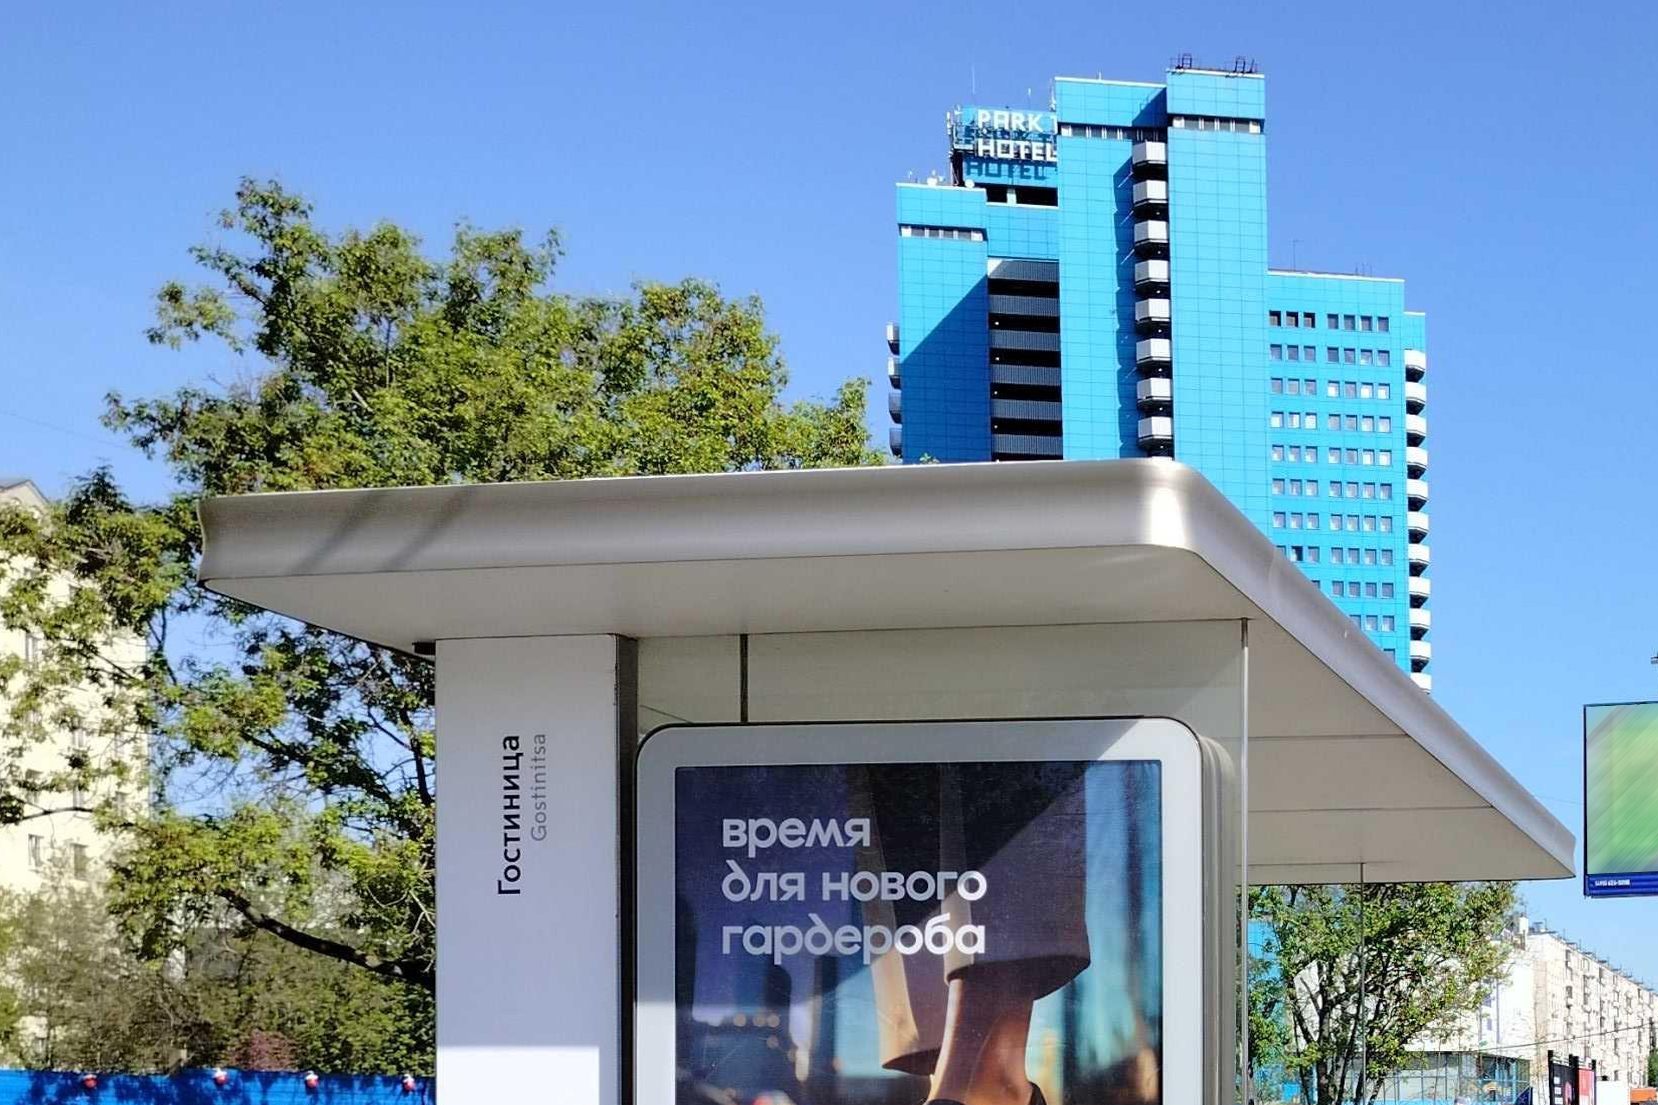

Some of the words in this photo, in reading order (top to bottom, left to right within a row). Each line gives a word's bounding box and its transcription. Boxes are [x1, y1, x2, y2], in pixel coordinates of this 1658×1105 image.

[977, 109, 1043, 132] PARK
[977, 138, 1057, 162] HOTEL
[530, 734, 548, 842] Gostinitsa
[497, 735, 524, 895] Гостиница
[722, 818, 871, 858] время
[721, 859, 805, 902] для
[821, 870, 988, 901] нового
[722, 913, 986, 965] гардероба
